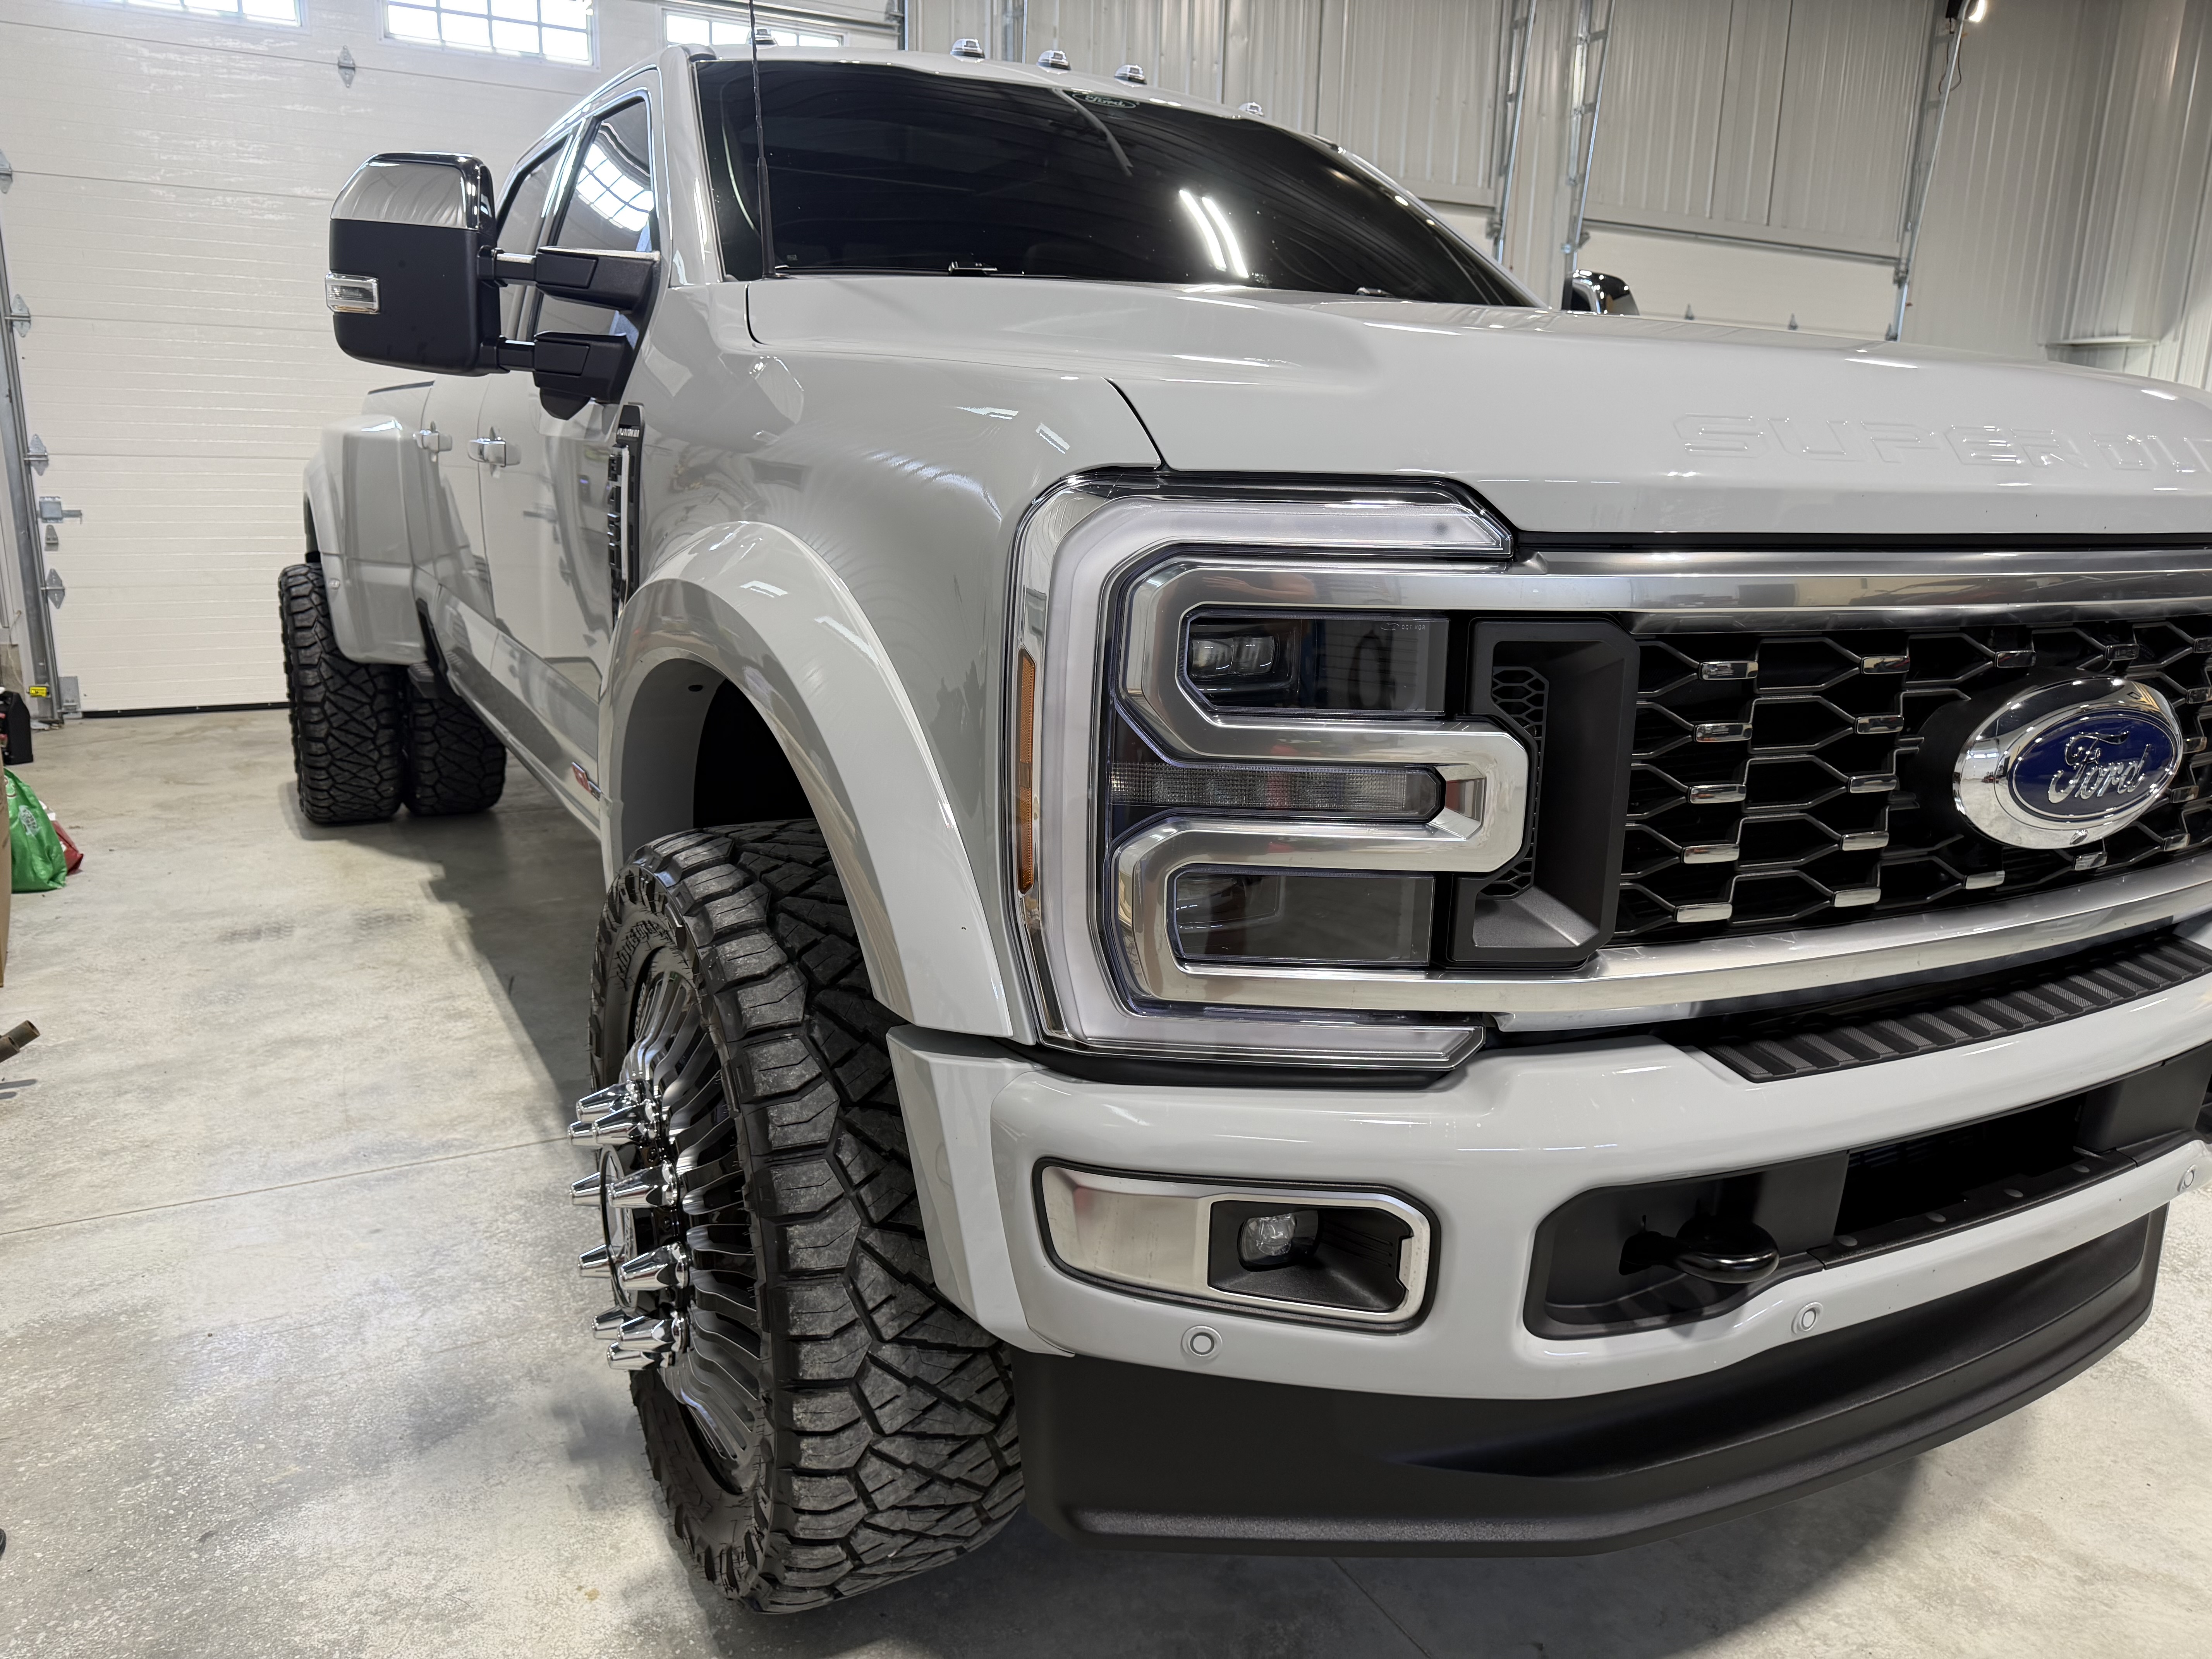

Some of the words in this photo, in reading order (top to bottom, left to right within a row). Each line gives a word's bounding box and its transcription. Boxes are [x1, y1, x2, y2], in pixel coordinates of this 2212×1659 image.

[1085, 95, 1125, 107] Ford
[1673, 412, 2089, 470] SUPER
[2048, 731, 2152, 804] Ford
